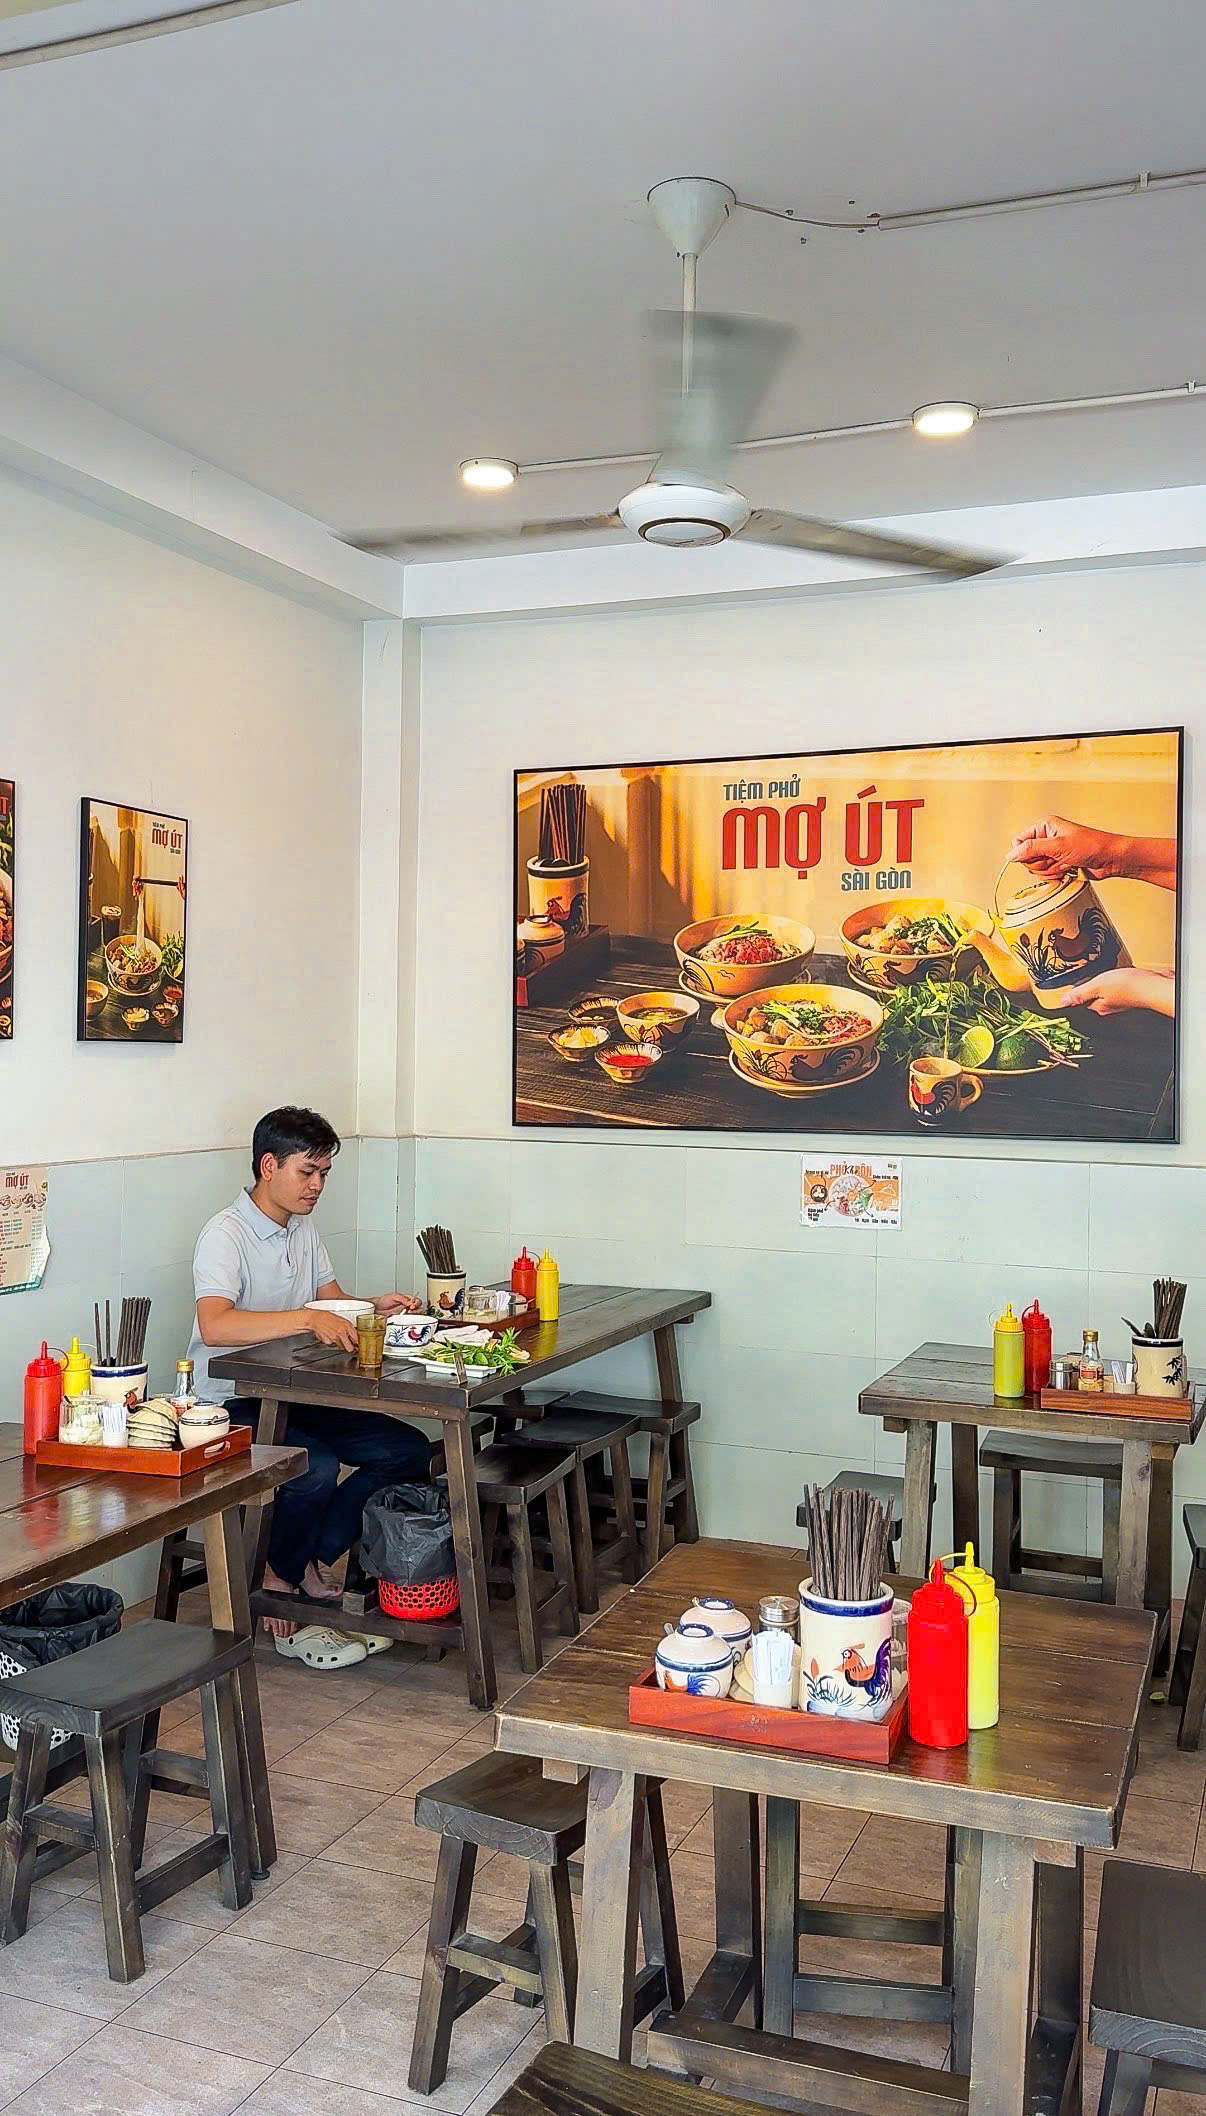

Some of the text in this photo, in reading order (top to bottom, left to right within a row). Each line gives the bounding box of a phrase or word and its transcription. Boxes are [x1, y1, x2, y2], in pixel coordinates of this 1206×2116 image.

[723, 774, 801, 803] TIỆM PHỞ
[152, 828, 183, 849] MỢ ÚT
[722, 784, 925, 880] MỢ ÚT
[841, 867, 912, 891] SÀI GÒN
[20, 1173, 30, 1186] ÚT
